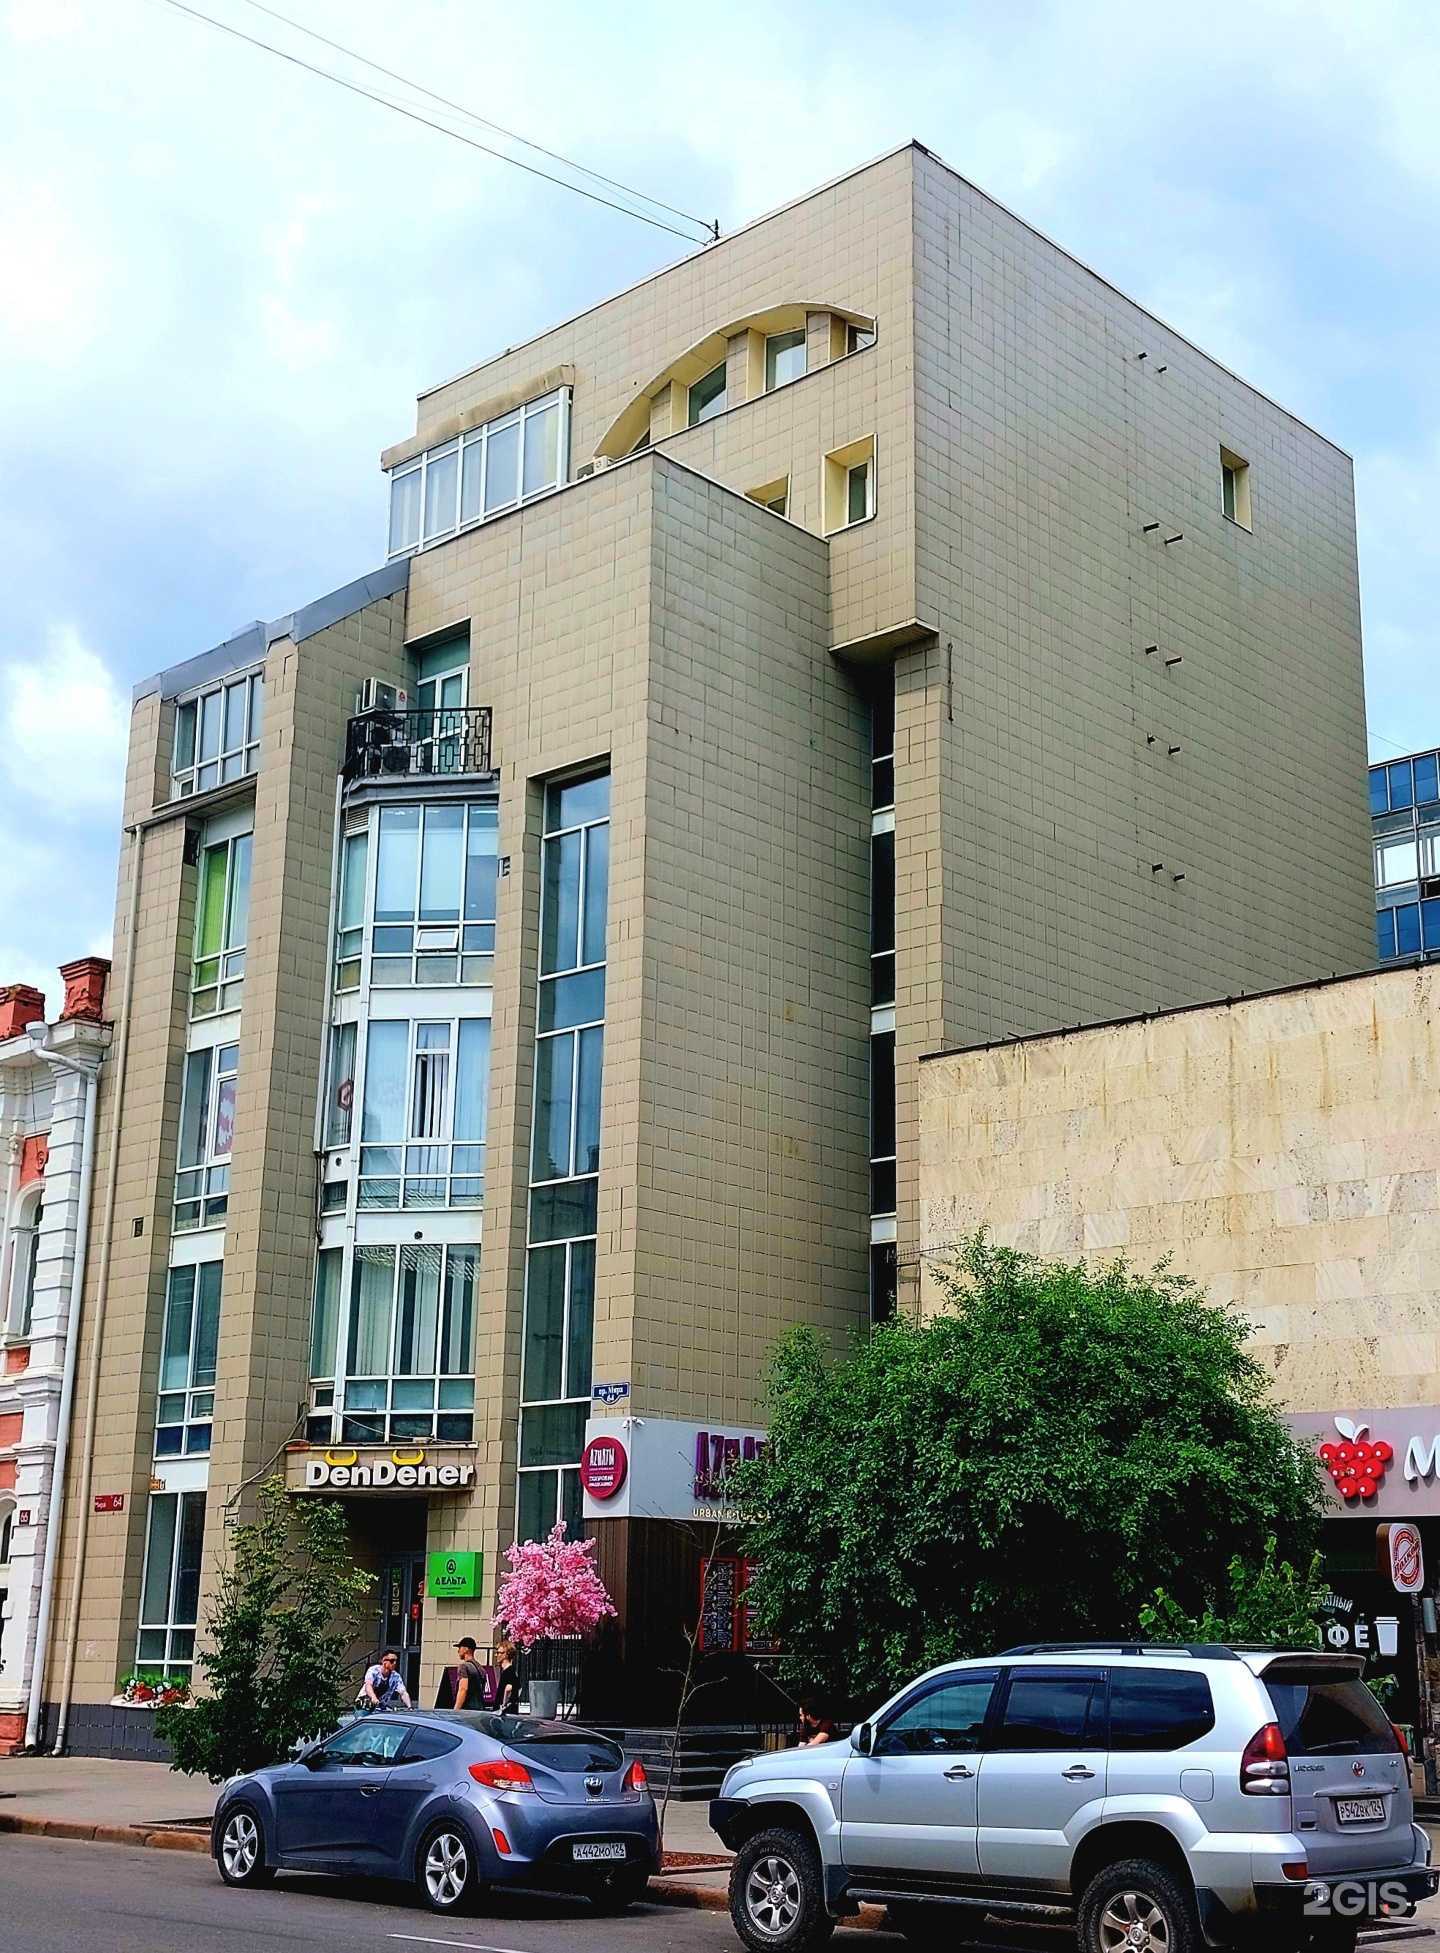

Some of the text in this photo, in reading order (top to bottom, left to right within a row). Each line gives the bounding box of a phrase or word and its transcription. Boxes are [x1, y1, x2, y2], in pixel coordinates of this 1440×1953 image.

[306, 1460, 474, 1487] DenDener
[112, 1495, 122, 1508] 64
[20, 1511, 29, 1523] 66
[693, 1507, 724, 1519] URBAN
[435, 1576, 467, 1585] ДЕЛЬТА
